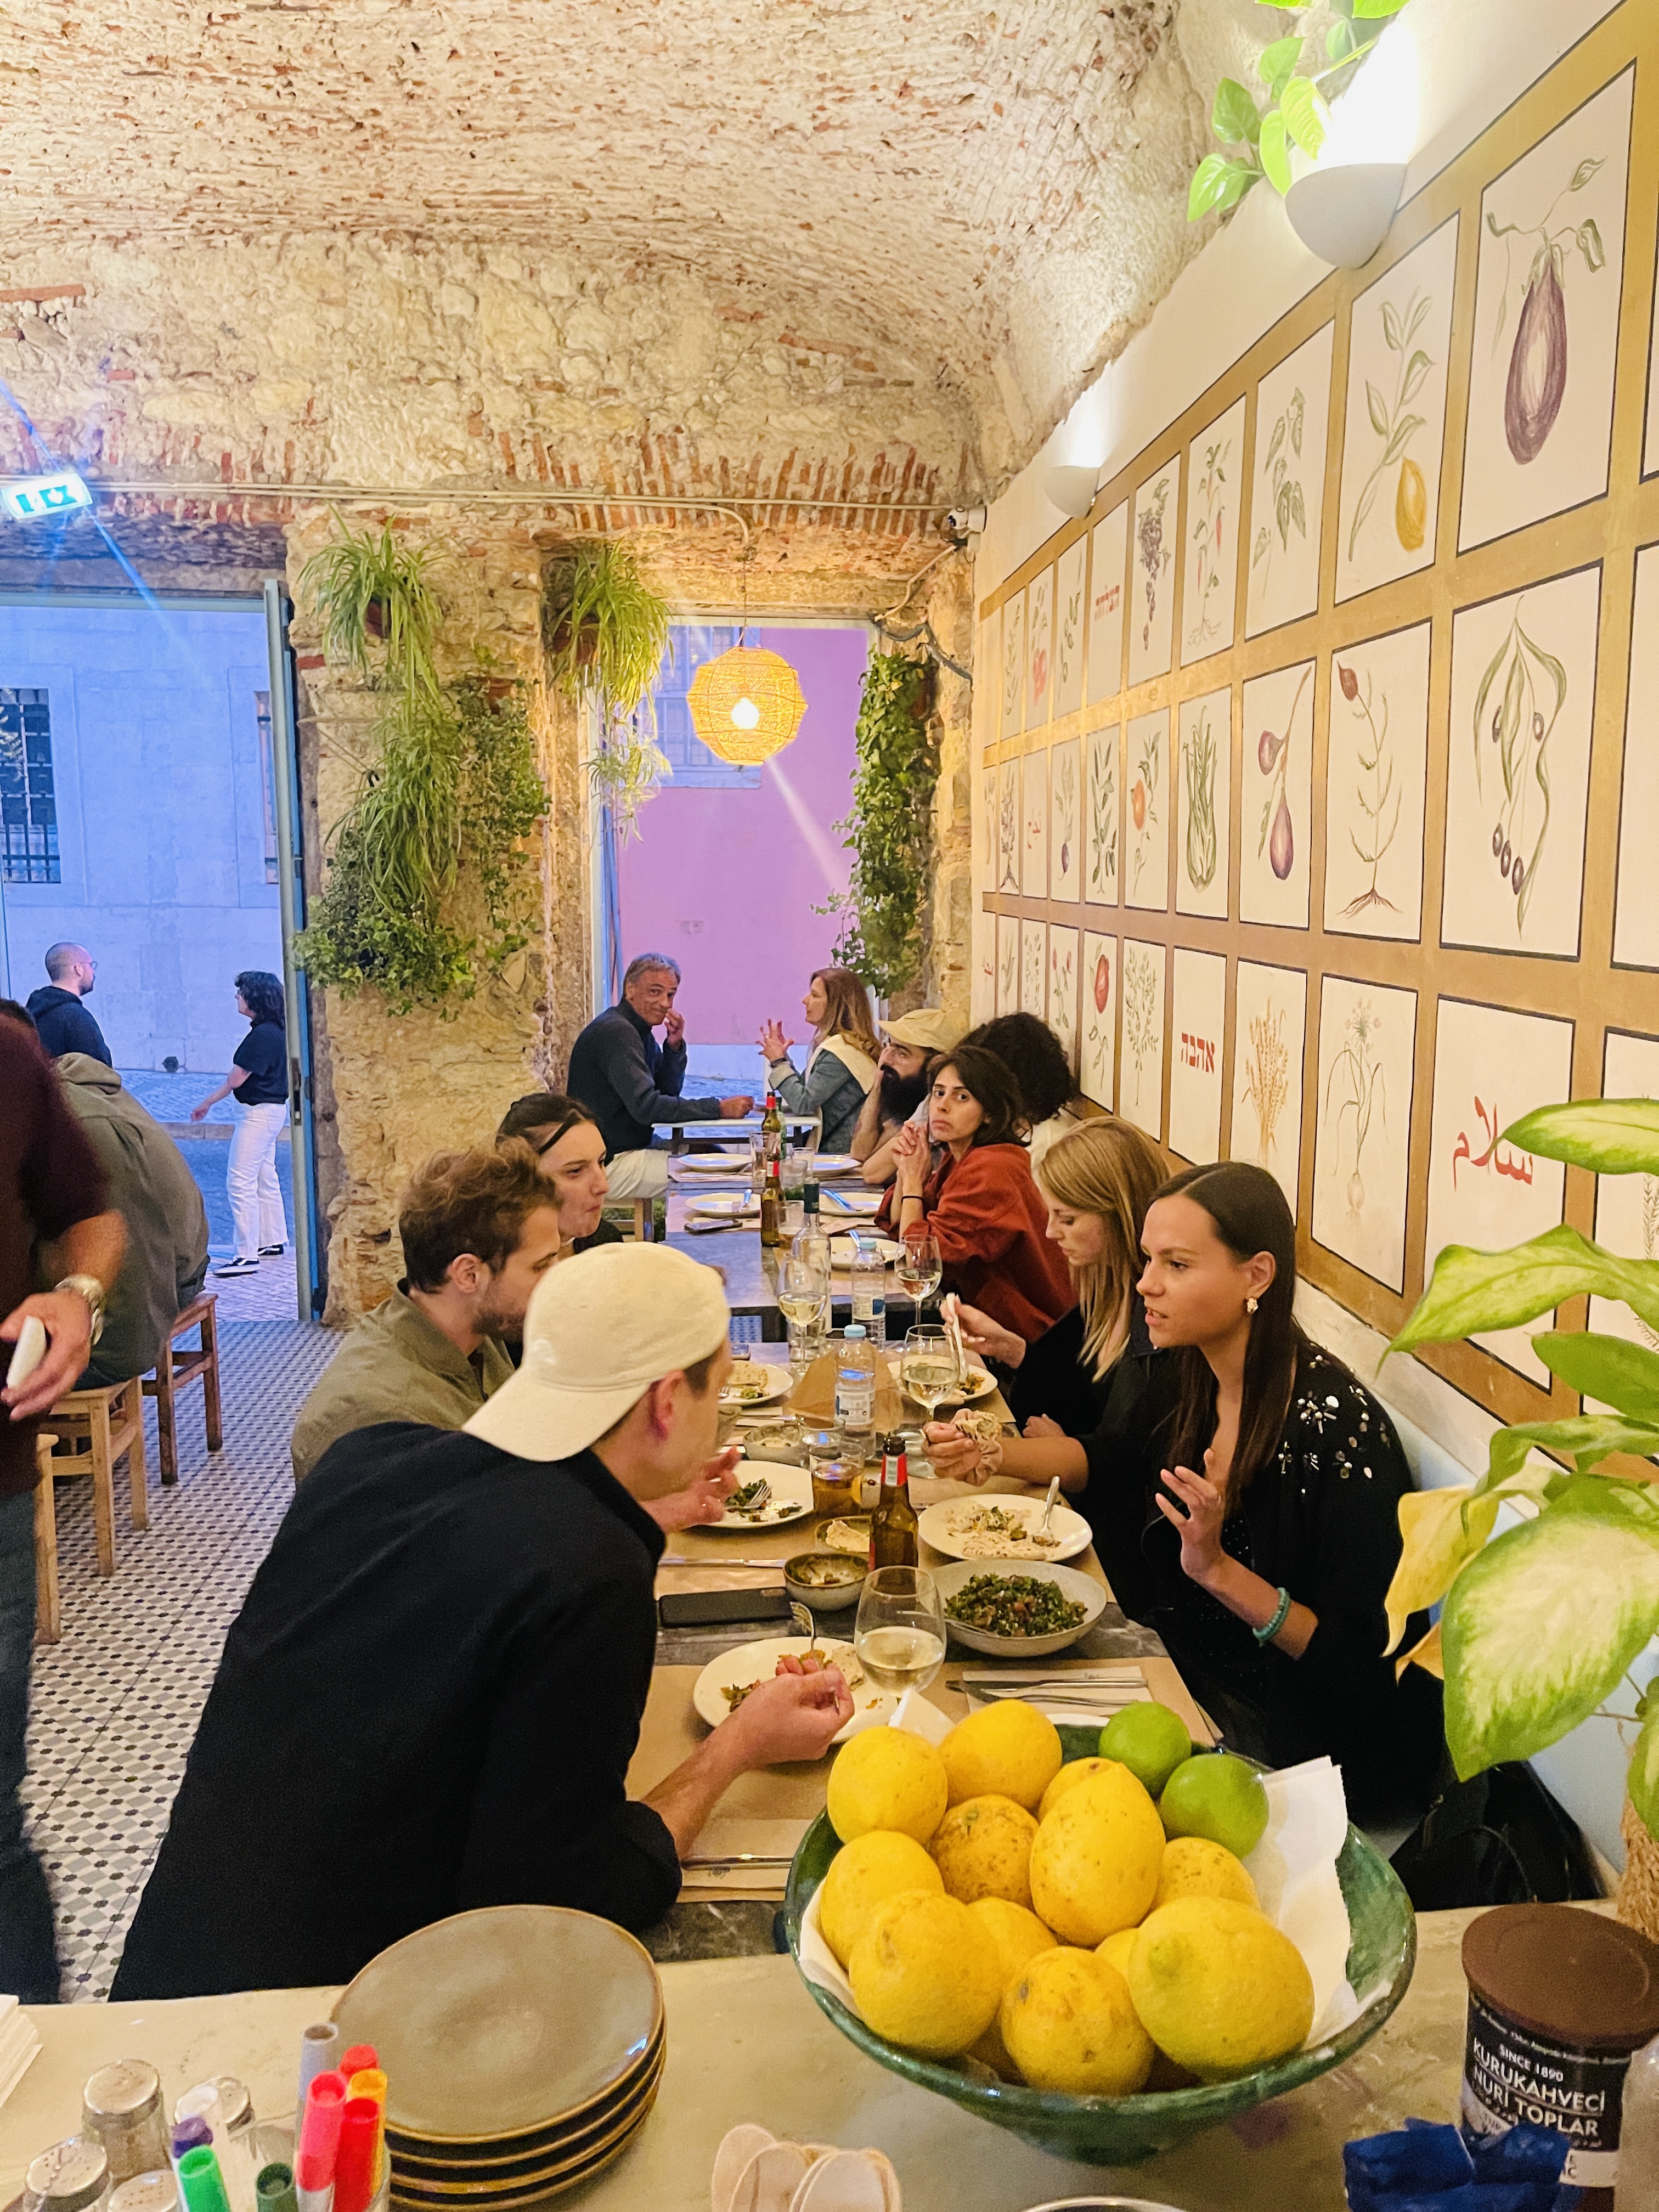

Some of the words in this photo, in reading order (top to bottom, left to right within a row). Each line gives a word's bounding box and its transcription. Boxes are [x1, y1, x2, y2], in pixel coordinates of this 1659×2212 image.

[1181, 1032, 1215, 1074] אהבה
[1453, 1096, 1533, 1191] سلام
[1499, 2044, 1531, 2070] SINCE
[1536, 2063, 1564, 2083] 1890
[1515, 2097, 1599, 2137] TOPLAR
